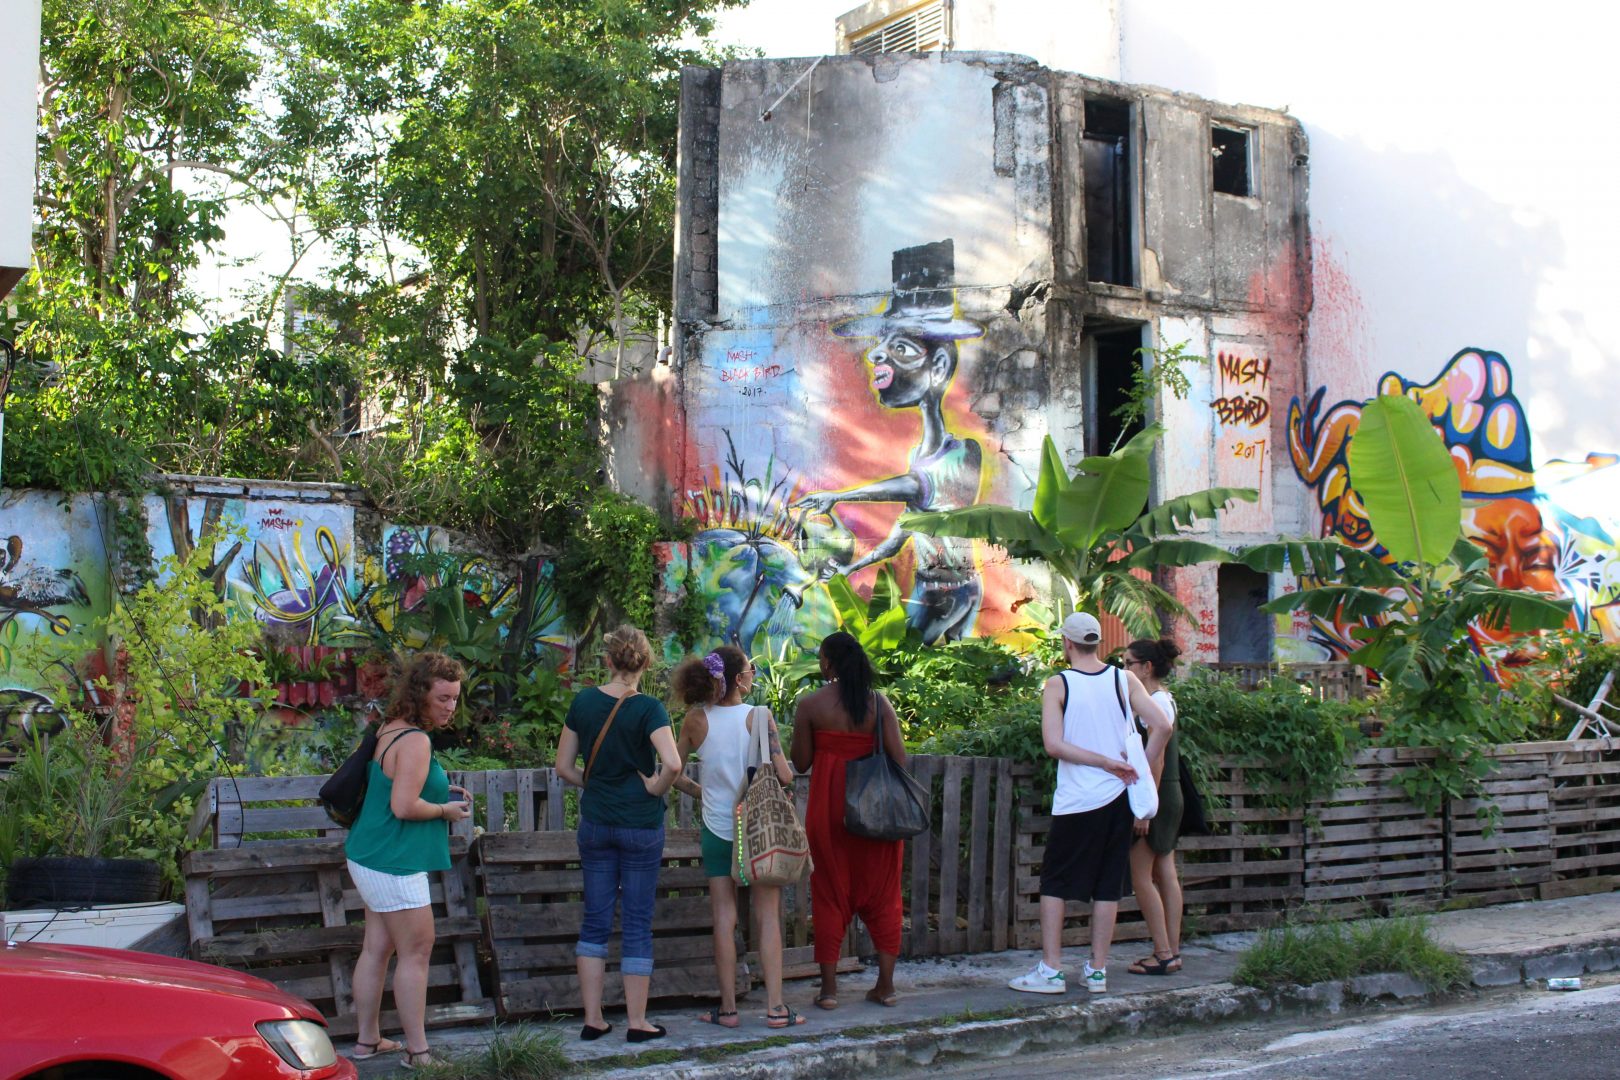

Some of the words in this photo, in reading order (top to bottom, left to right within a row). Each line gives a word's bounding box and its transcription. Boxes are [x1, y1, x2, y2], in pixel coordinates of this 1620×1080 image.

[1218, 351, 1271, 392] MASH
[1233, 439, 1266, 470] 2017
[748, 832, 767, 859] 150
